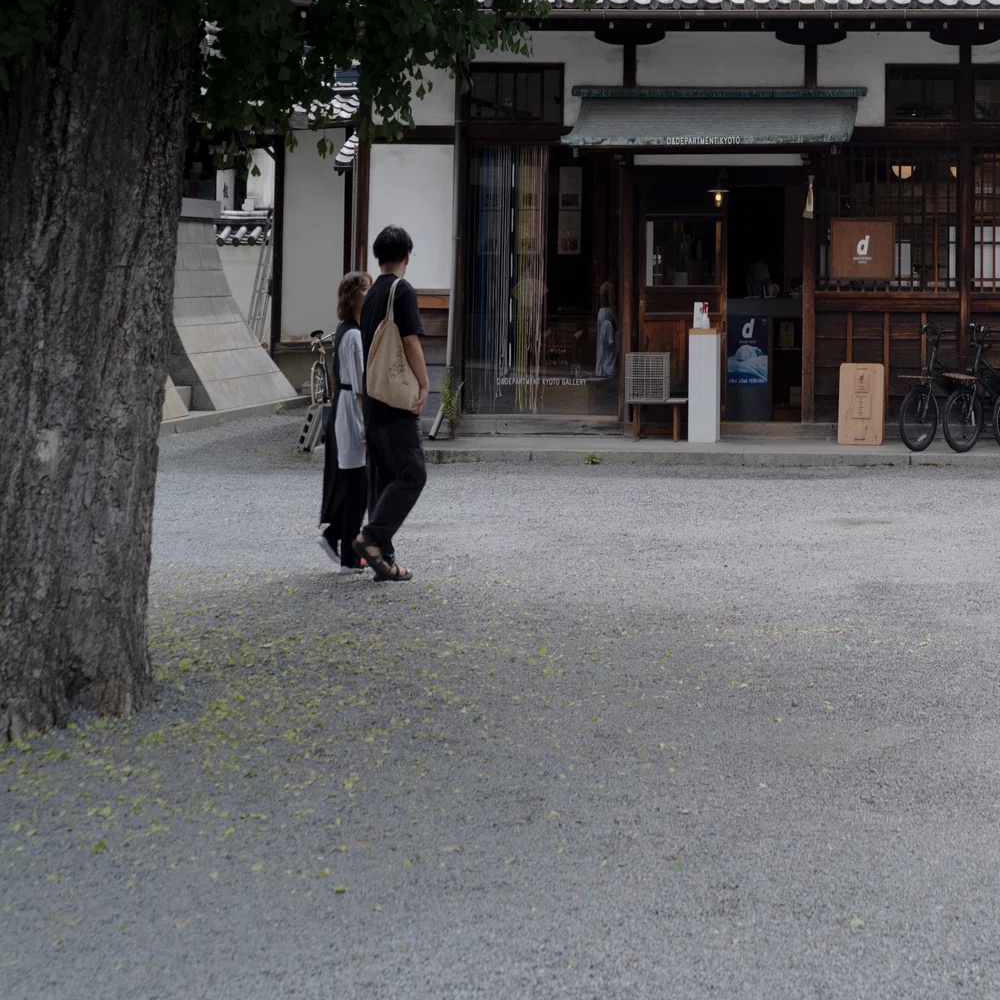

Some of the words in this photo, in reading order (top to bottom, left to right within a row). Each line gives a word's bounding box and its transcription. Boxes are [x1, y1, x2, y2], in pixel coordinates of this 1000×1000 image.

[666, 136, 717, 145] D&DEPARTMENT
[719, 136, 741, 145] KYOTO
[856, 234, 870, 256] d
[741, 317, 755, 339] d
[496, 377, 540, 386] D&DEPARTMENT
[542, 377, 560, 386] KYOTO
[561, 377, 587, 386] GALLERY
